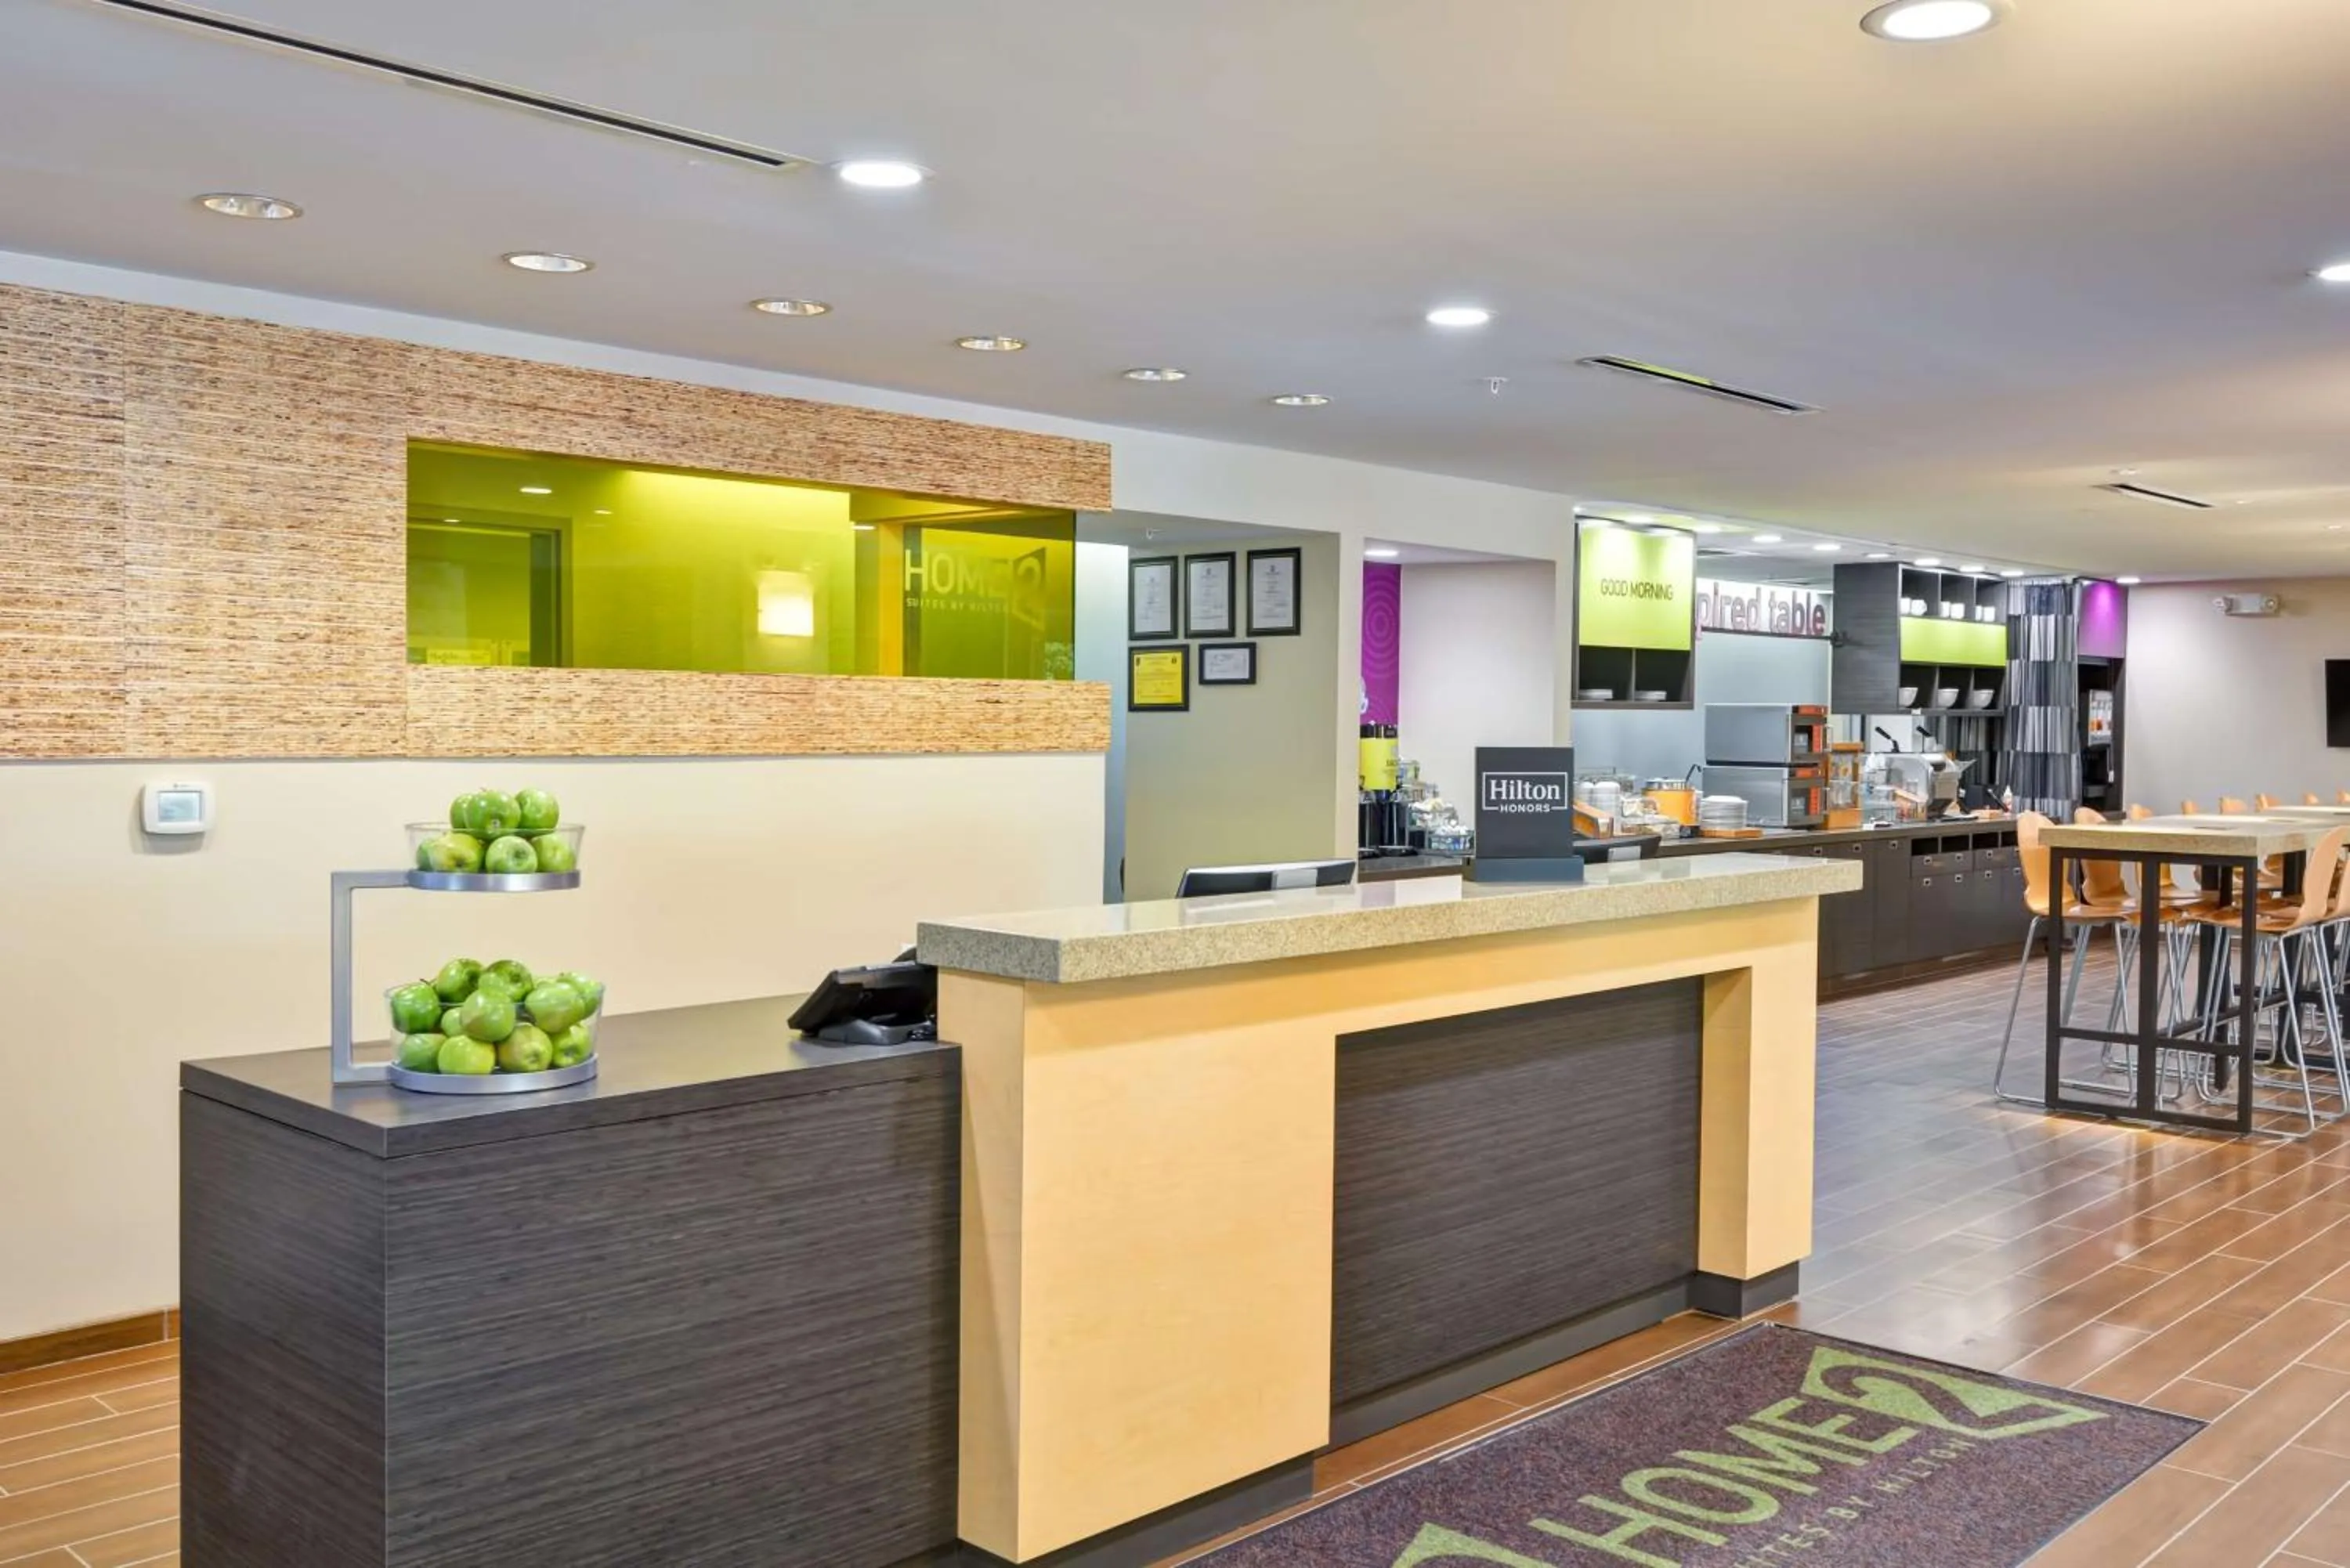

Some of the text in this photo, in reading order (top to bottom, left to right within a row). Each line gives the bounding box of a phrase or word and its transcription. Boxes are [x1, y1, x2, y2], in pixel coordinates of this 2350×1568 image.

[1600, 578, 1673, 601] GOOD MORNING
[1696, 582, 1825, 640] pired table
[1490, 779, 1560, 800] Hilton
[1500, 803, 1550, 812] HONORS
[1733, 1438, 1977, 1568] ITES BY HILTON
